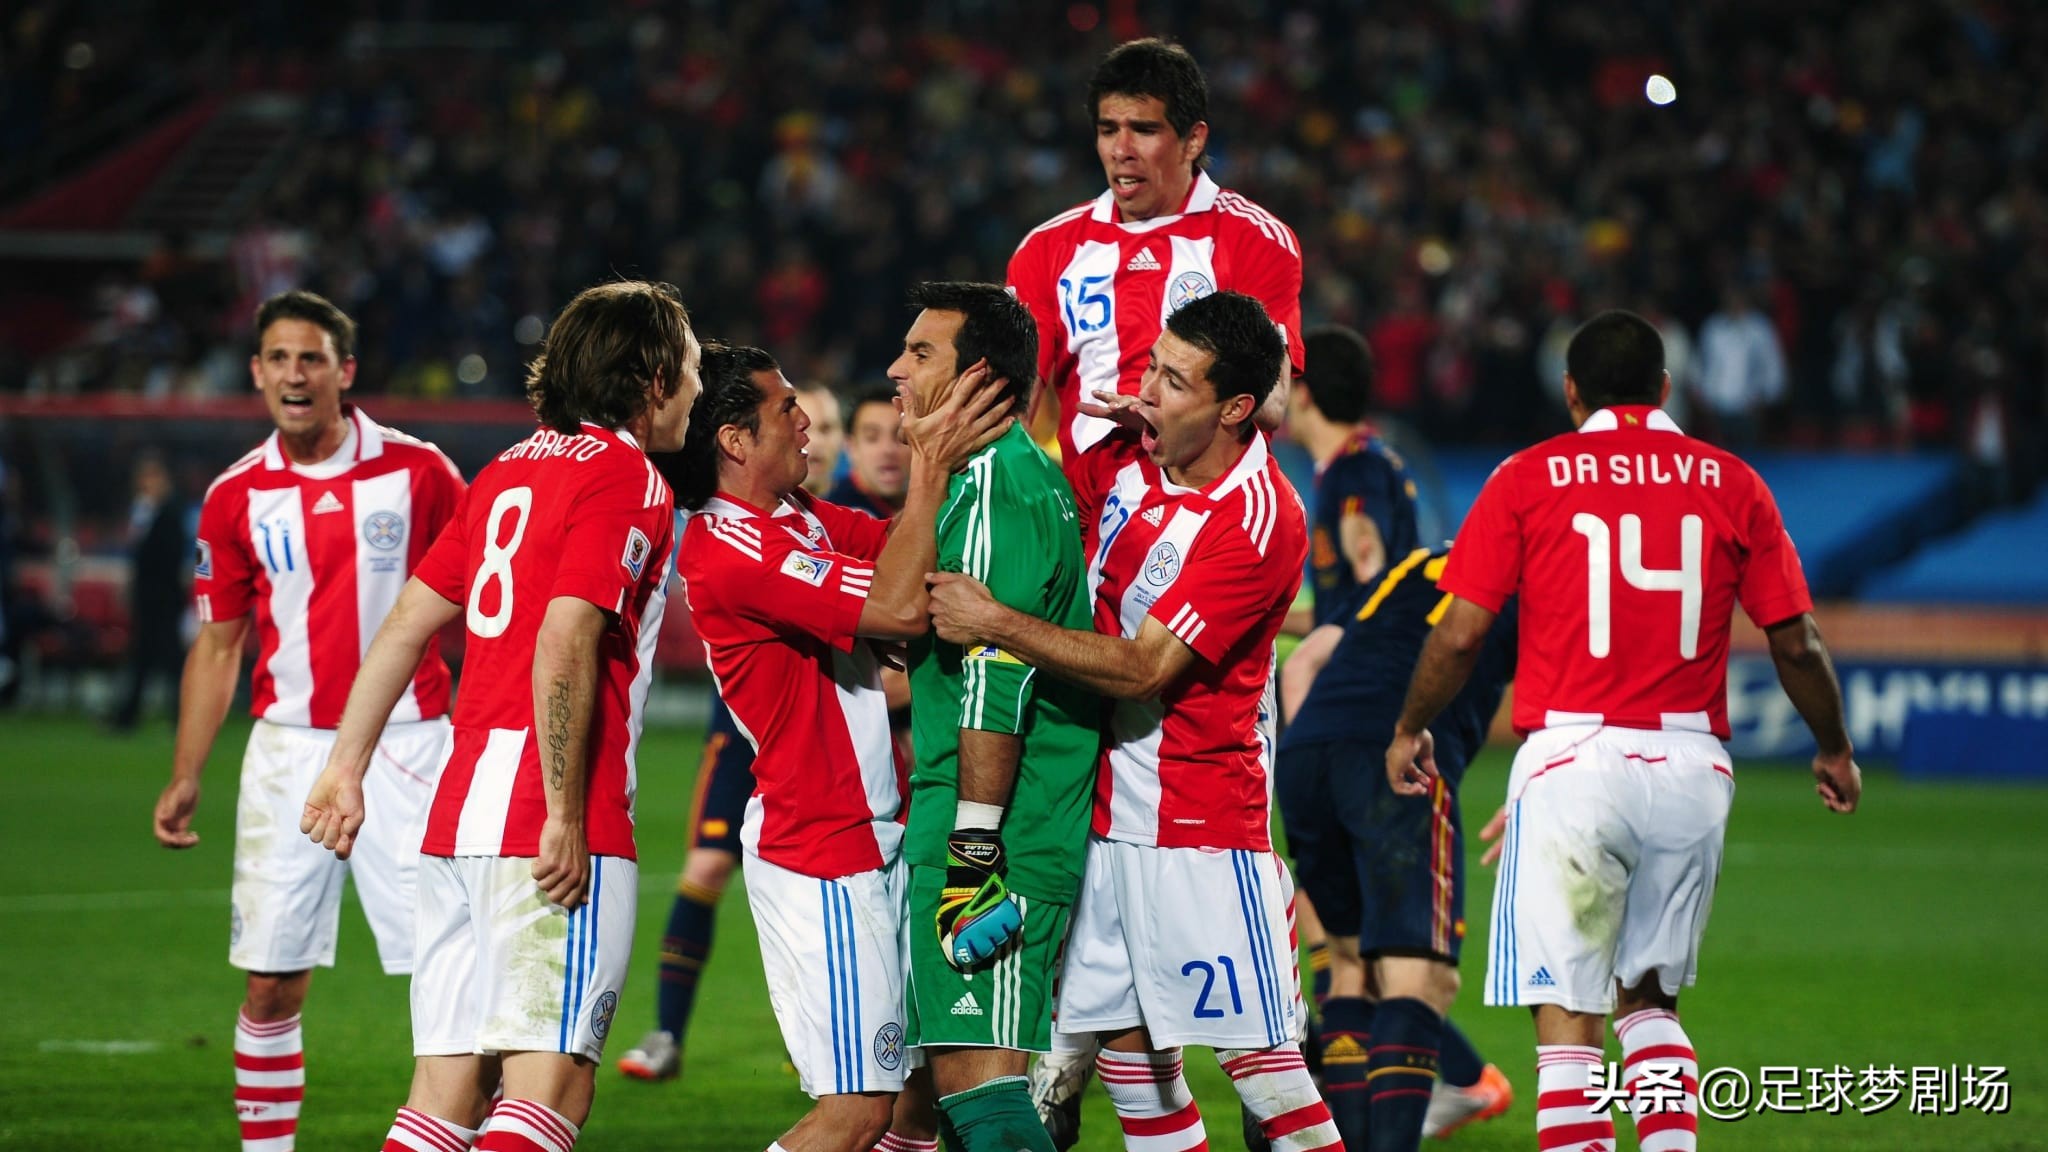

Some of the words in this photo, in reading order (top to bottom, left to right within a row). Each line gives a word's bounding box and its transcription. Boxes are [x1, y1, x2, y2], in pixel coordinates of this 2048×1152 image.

[1127, 261, 1161, 271] adidas
[1060, 275, 1112, 337] 15
[1547, 453, 1599, 487] DA
[1608, 453, 1720, 488] SILVA
[258, 518, 294, 574] 11
[467, 486, 532, 638] 8
[1572, 512, 1703, 661] 14
[951, 1004, 983, 1016] adidas
[1181, 955, 1243, 1018] 21
